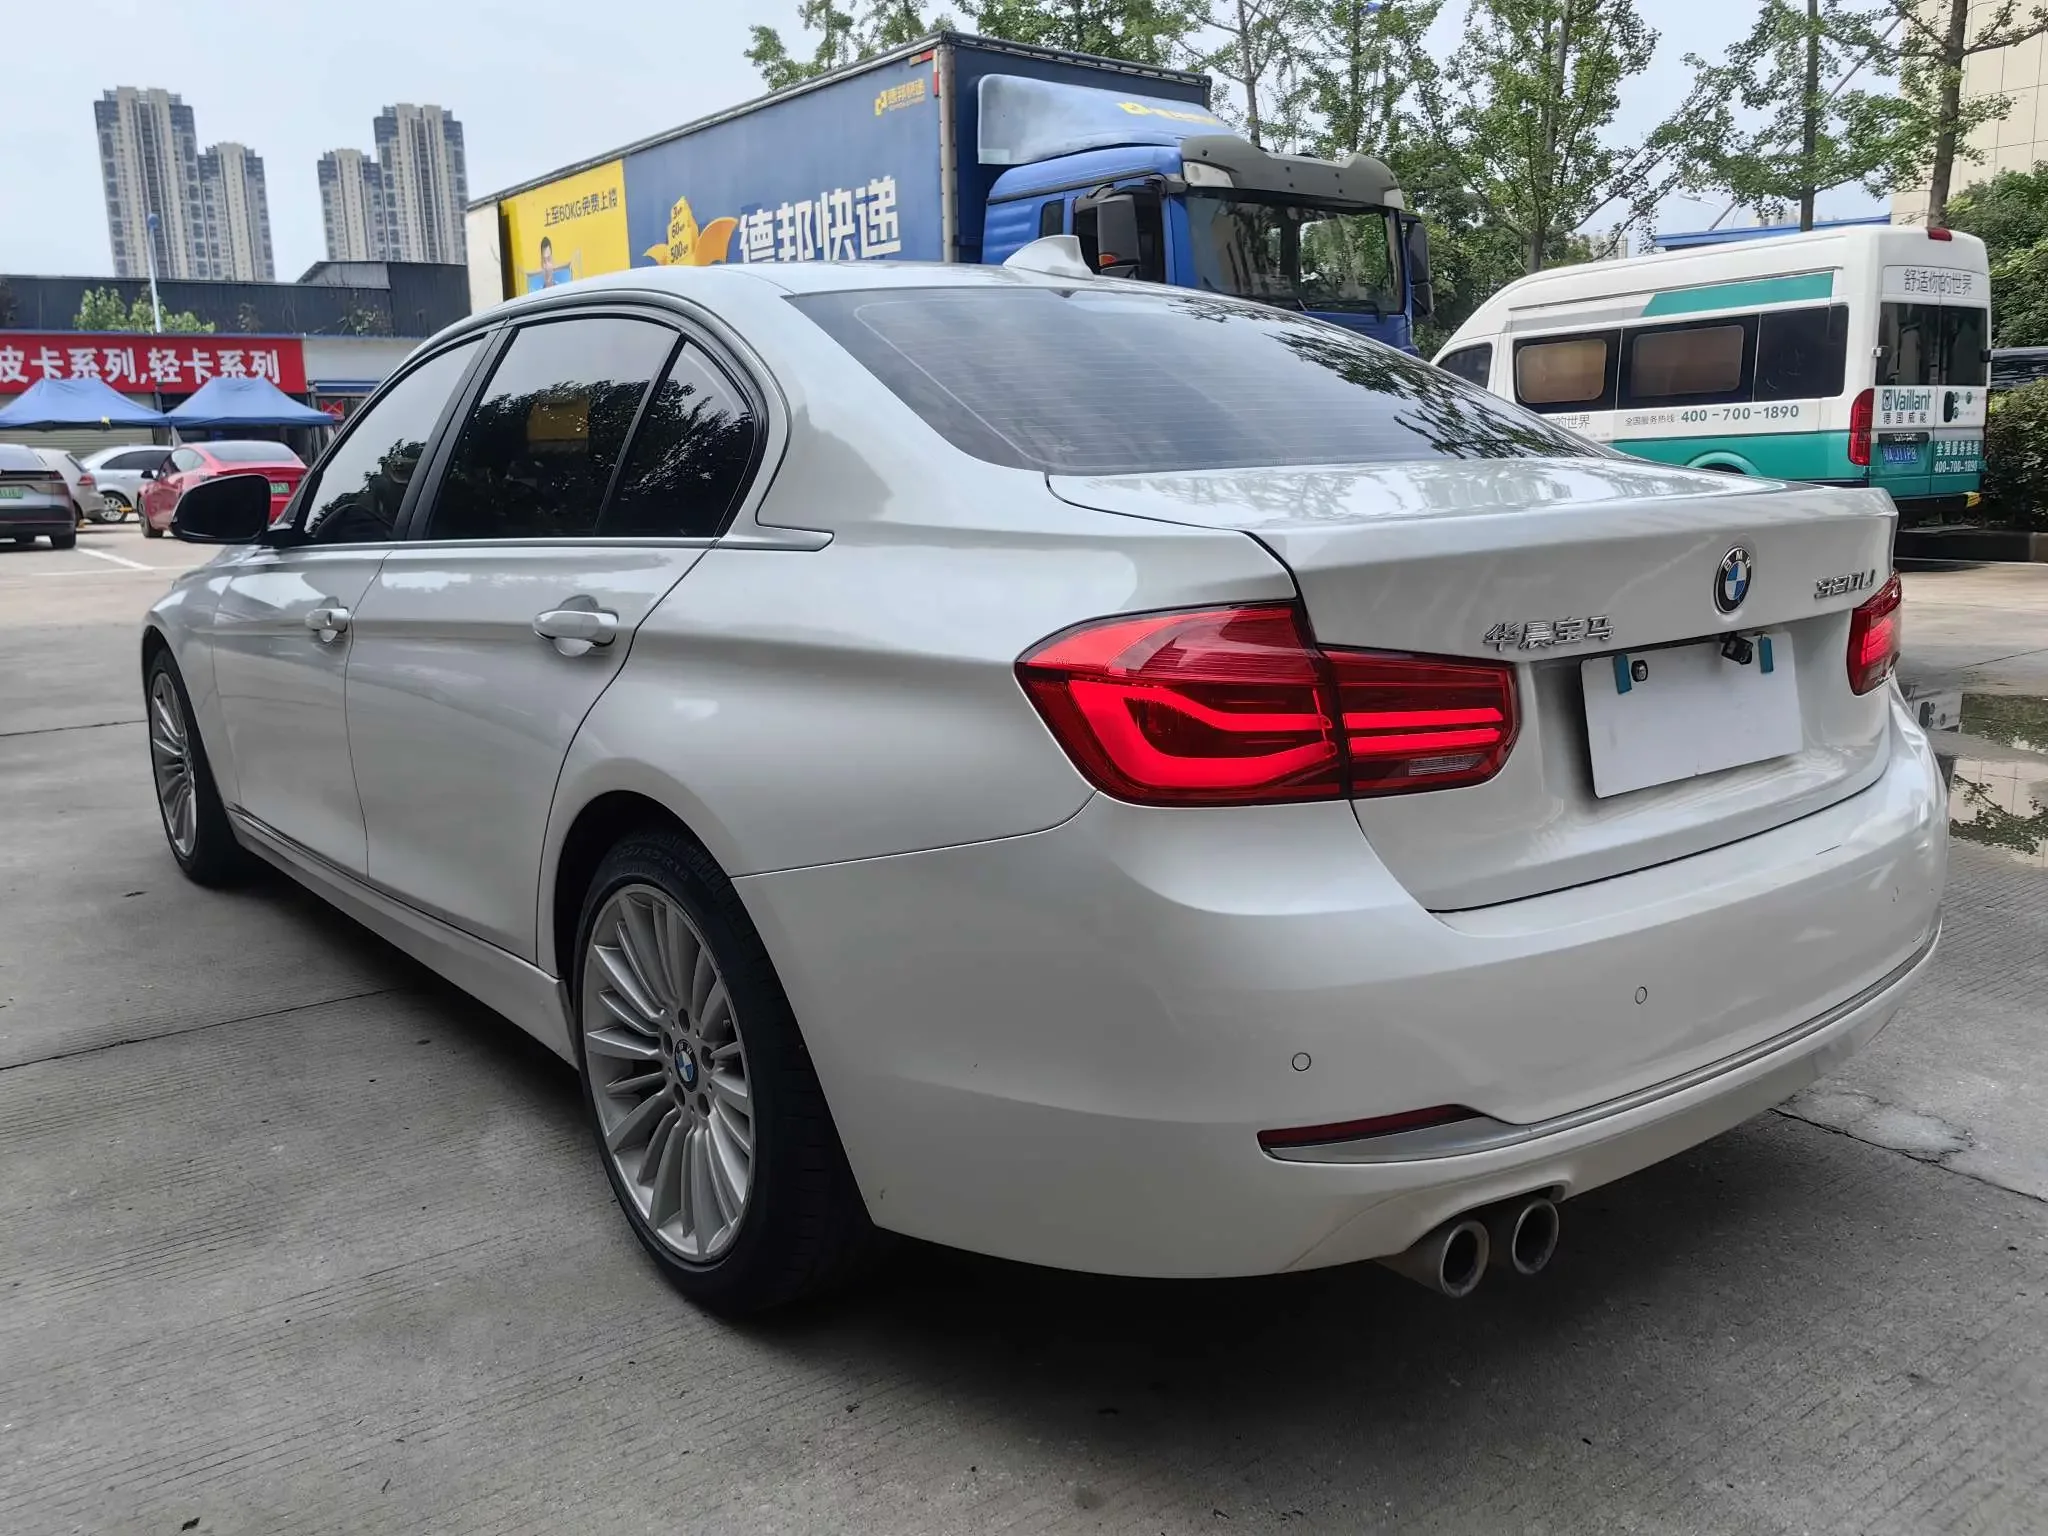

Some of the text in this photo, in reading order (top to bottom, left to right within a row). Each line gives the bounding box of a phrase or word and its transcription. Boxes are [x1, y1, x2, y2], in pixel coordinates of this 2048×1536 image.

[739, 175, 901, 264] 德邦快递
[1904, 268, 1972, 296] 舒适你的世界
[1893, 389, 1931, 411] Vaillant
[1483, 616, 1614, 651] 华晨宝马
